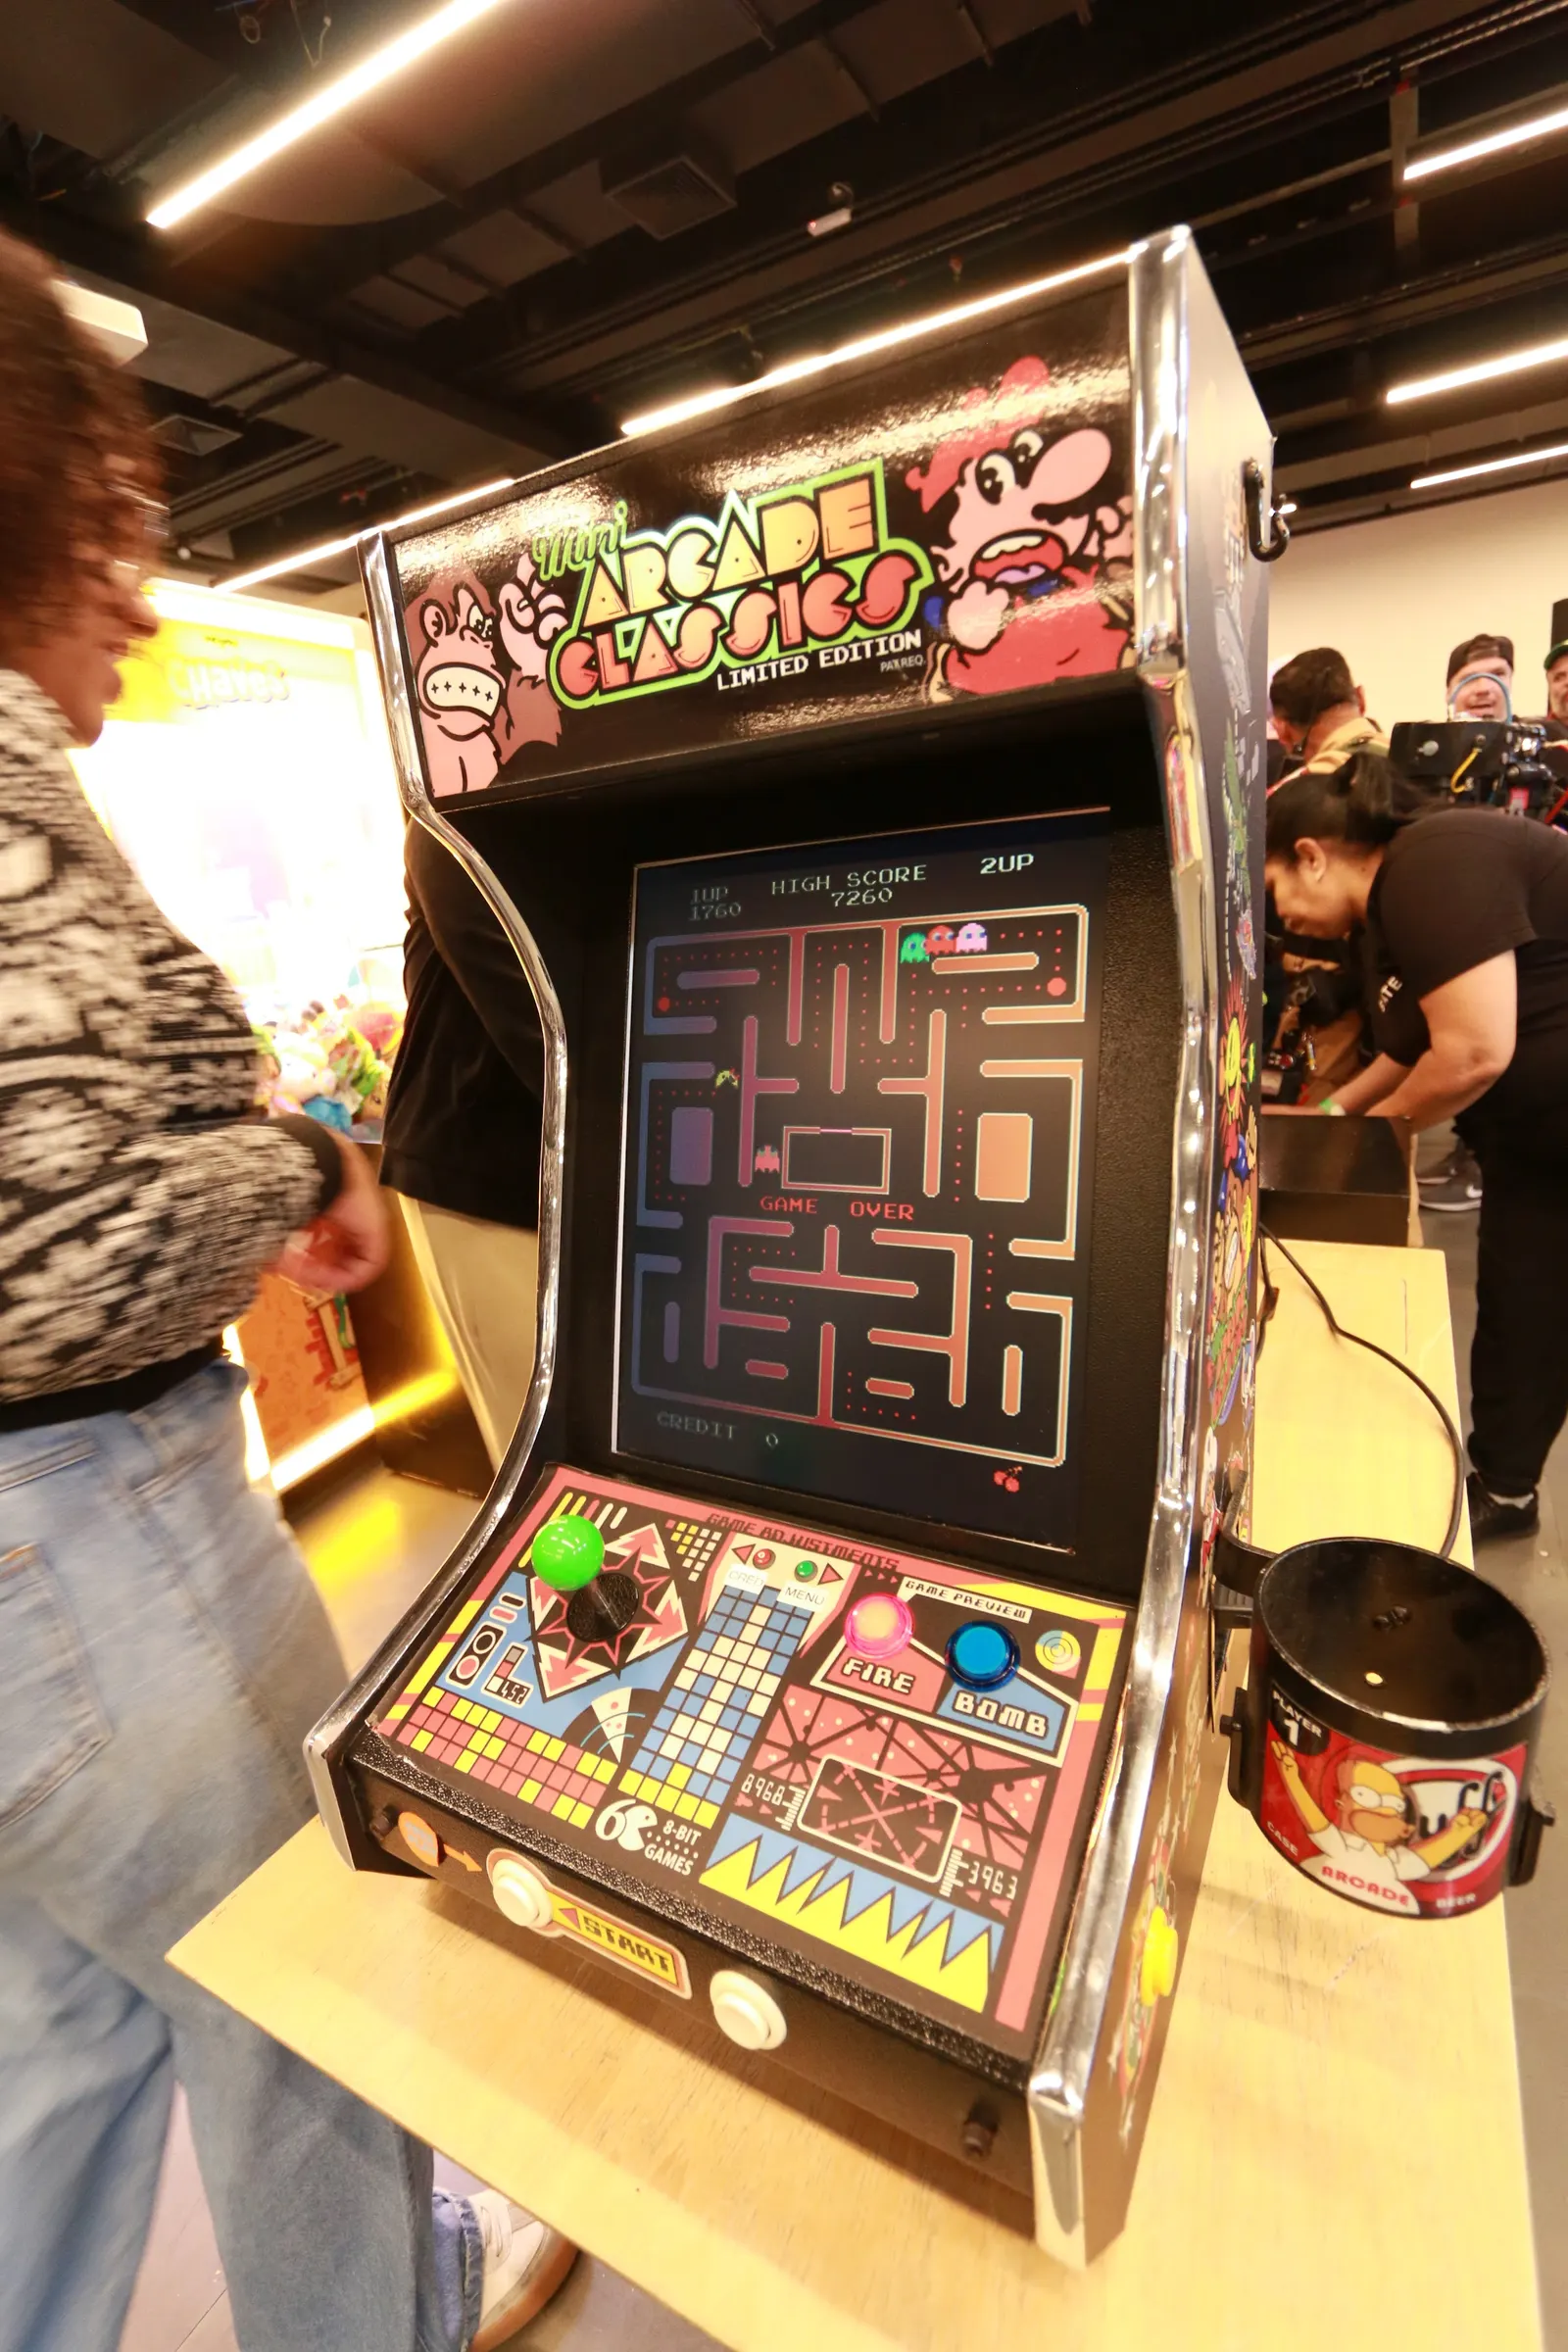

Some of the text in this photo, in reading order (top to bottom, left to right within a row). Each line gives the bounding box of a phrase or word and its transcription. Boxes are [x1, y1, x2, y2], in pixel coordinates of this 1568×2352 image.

[580, 475, 877, 629] ARCADE
[557, 551, 917, 698] CLASSICS
[716, 628, 922, 691] LIMITED EDITION
[771, 864, 927, 896] HIGH SCORE
[980, 853, 1035, 875] 2UP
[688, 902, 742, 921] 1760
[690, 886, 729, 905] 1UP
[831, 887, 894, 907] 7260
[760, 1195, 914, 1221] GAME OVER
[656, 1410, 779, 1449] CREDIT 0
[706, 1513, 901, 1571] GAME ADJUSTMENTS
[727, 1569, 764, 1588] CRED
[784, 1586, 826, 1606] MENU
[905, 1579, 1027, 1619] GAME PREVIEW
[842, 1657, 915, 1695] FIRE
[954, 1691, 1049, 1740] BOMB
[1273, 1690, 1322, 1739] PLAYER
[1284, 1719, 1299, 1746] 1
[741, 1773, 786, 1806] 8968
[662, 1819, 702, 1846] 8-BIT
[1266, 1820, 1298, 1857] CASE
[644, 1843, 694, 1876] GAMES
[967, 1860, 1018, 1900] 3963
[1321, 1865, 1409, 1907] ARCADE
[583, 1915, 670, 1973] START
